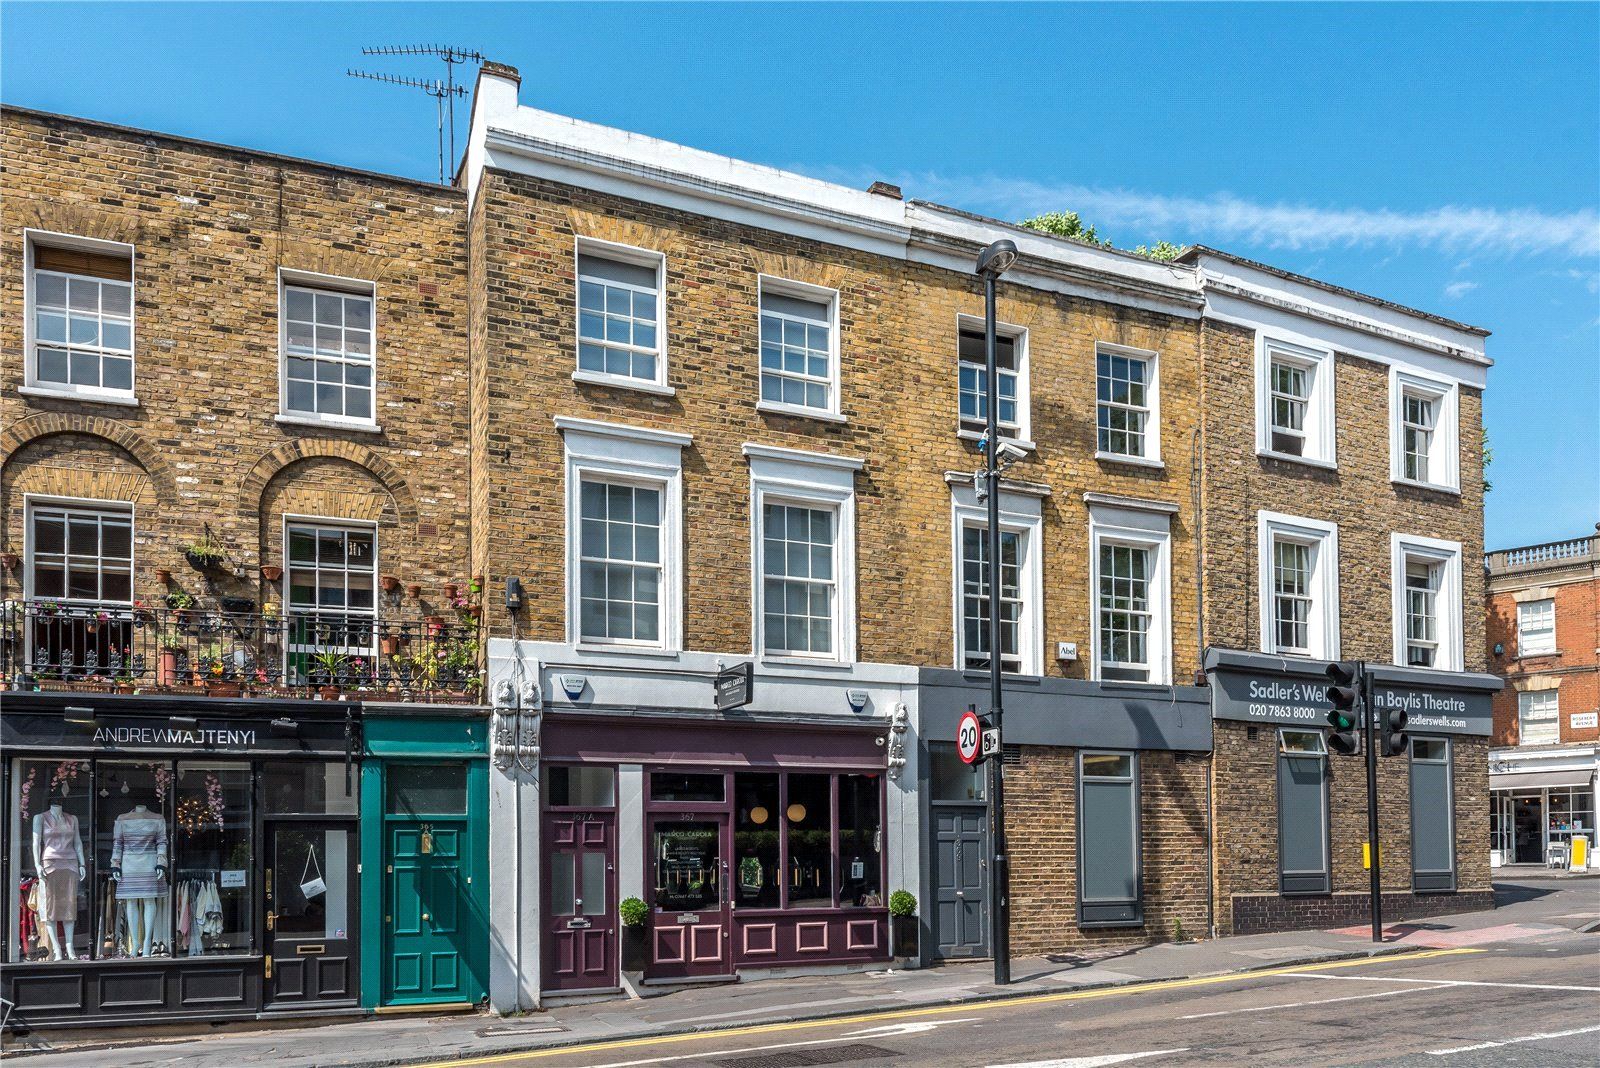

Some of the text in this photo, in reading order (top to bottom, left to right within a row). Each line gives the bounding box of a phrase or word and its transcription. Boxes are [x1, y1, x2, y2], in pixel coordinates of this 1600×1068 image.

[1060, 646, 1076, 655] Abel
[1249, 680, 1301, 701] Sadler's
[1301, 684, 1331, 703] Well
[1386, 690, 1421, 711] Baylis
[1422, 693, 1466, 712] Theatre
[1249, 704, 1316, 719] 020 7863 8000
[960, 726, 977, 749] 20
